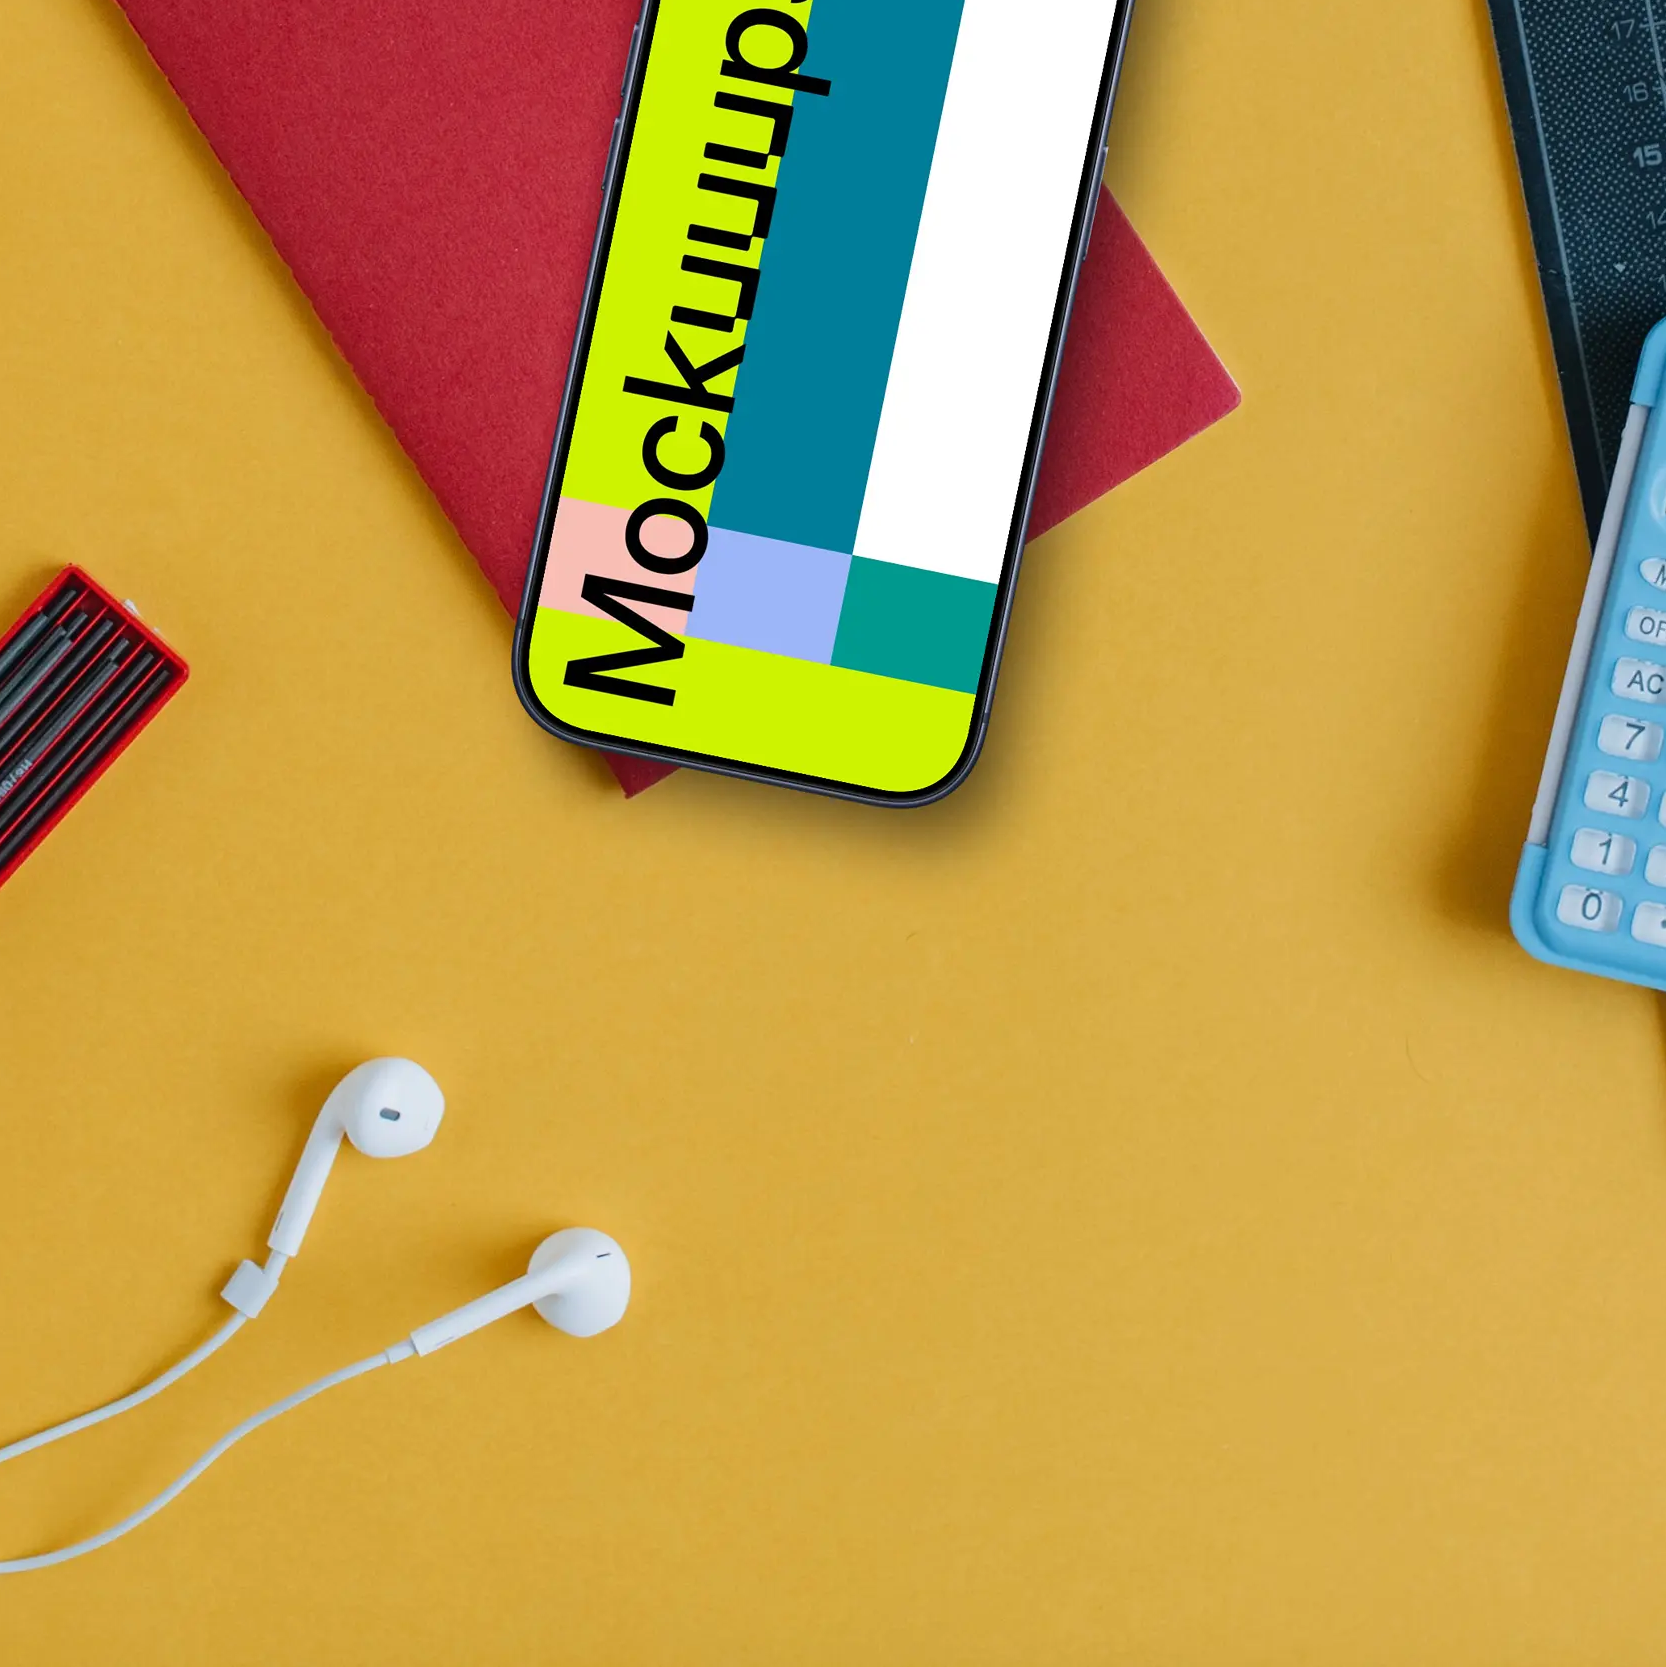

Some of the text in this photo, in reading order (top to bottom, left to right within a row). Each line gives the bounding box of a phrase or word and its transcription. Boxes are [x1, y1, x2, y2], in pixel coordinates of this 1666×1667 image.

[1611, 19, 1636, 38] 17
[1623, 82, 1648, 103] 16
[1633, 145, 1663, 167] 15
[1627, 670, 1665, 695] AC
[1626, 722, 1645, 750] 7
[1608, 780, 1629, 808] 4
[1599, 837, 1612, 865] 1
[1581, 892, 1602, 921] 0
